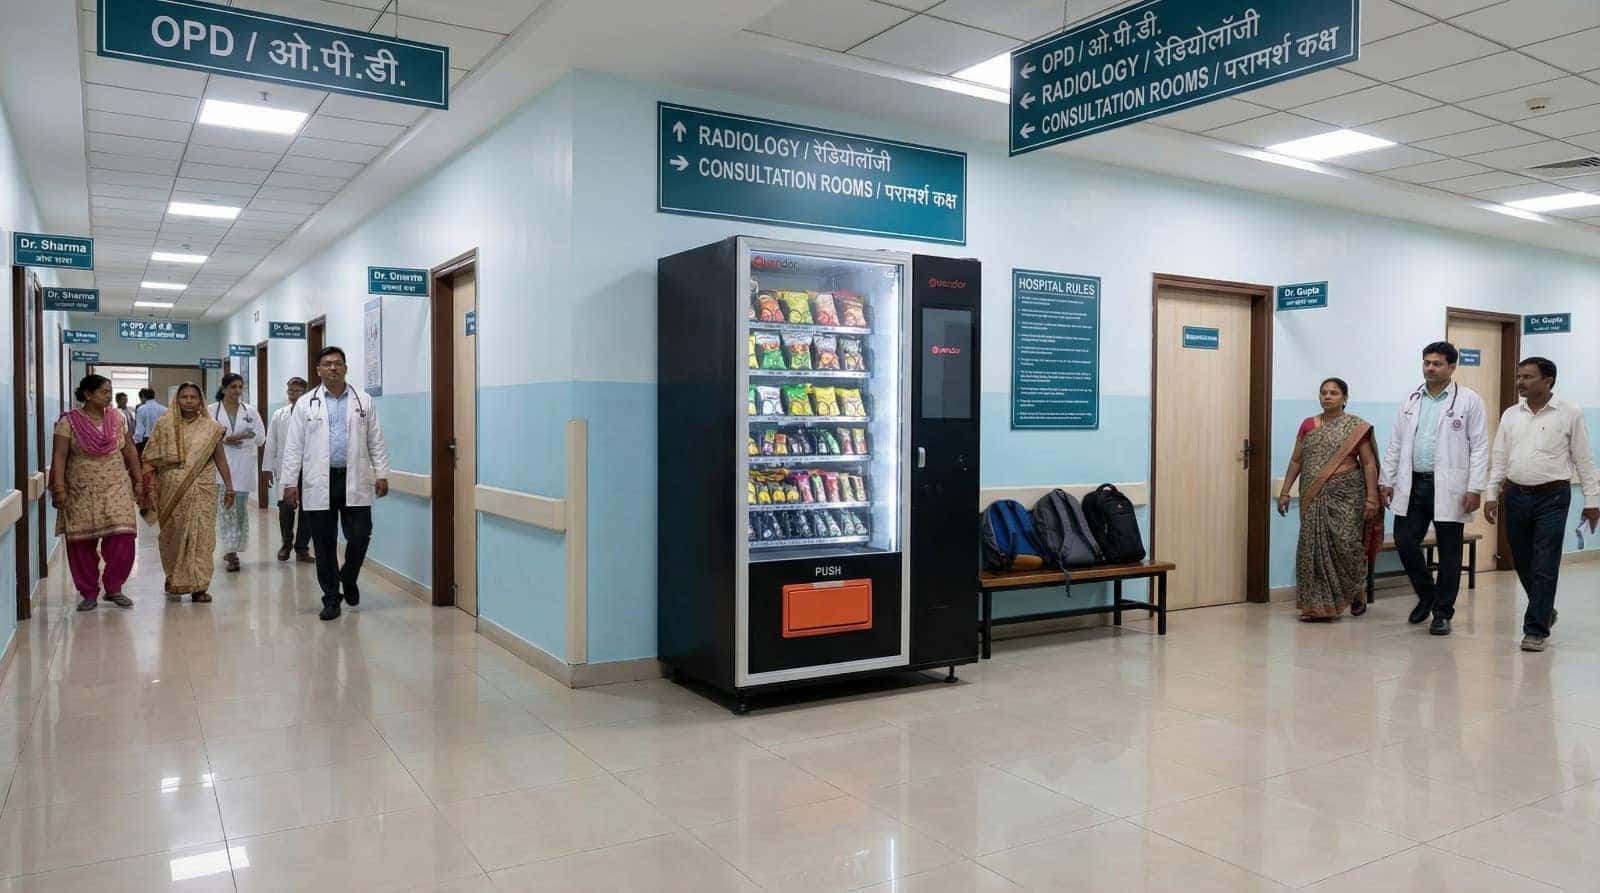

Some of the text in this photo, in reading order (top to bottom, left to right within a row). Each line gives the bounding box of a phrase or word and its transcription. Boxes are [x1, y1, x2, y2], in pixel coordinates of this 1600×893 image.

[151, 15, 407, 87] OPD / ओ.पी.डी.
[1042, 10, 1162, 74] OPD / ओ.पी.डी.
[1042, 8, 1261, 105] RADIOLOGY / रेडियोलॉजी
[1042, 26, 1340, 134] CONSULTATION ROOMS / परामर्श कक्ष
[699, 125, 892, 173] RADIOLOGY / रेडियोलॉजी
[699, 157, 958, 209] CONSULTATION ROOMS / परामर्श कक्ष
[20, 238, 87, 254] Dr. Sharma
[374, 271, 387, 280] Dr.
[47, 290, 95, 300] Dr. Sharma
[1018, 277, 1096, 296] HOSPITAL RULES
[1284, 287, 1320, 297] Dr. Gupta
[1542, 317, 1563, 325] Gupta
[815, 566, 842, 577] PUSH
